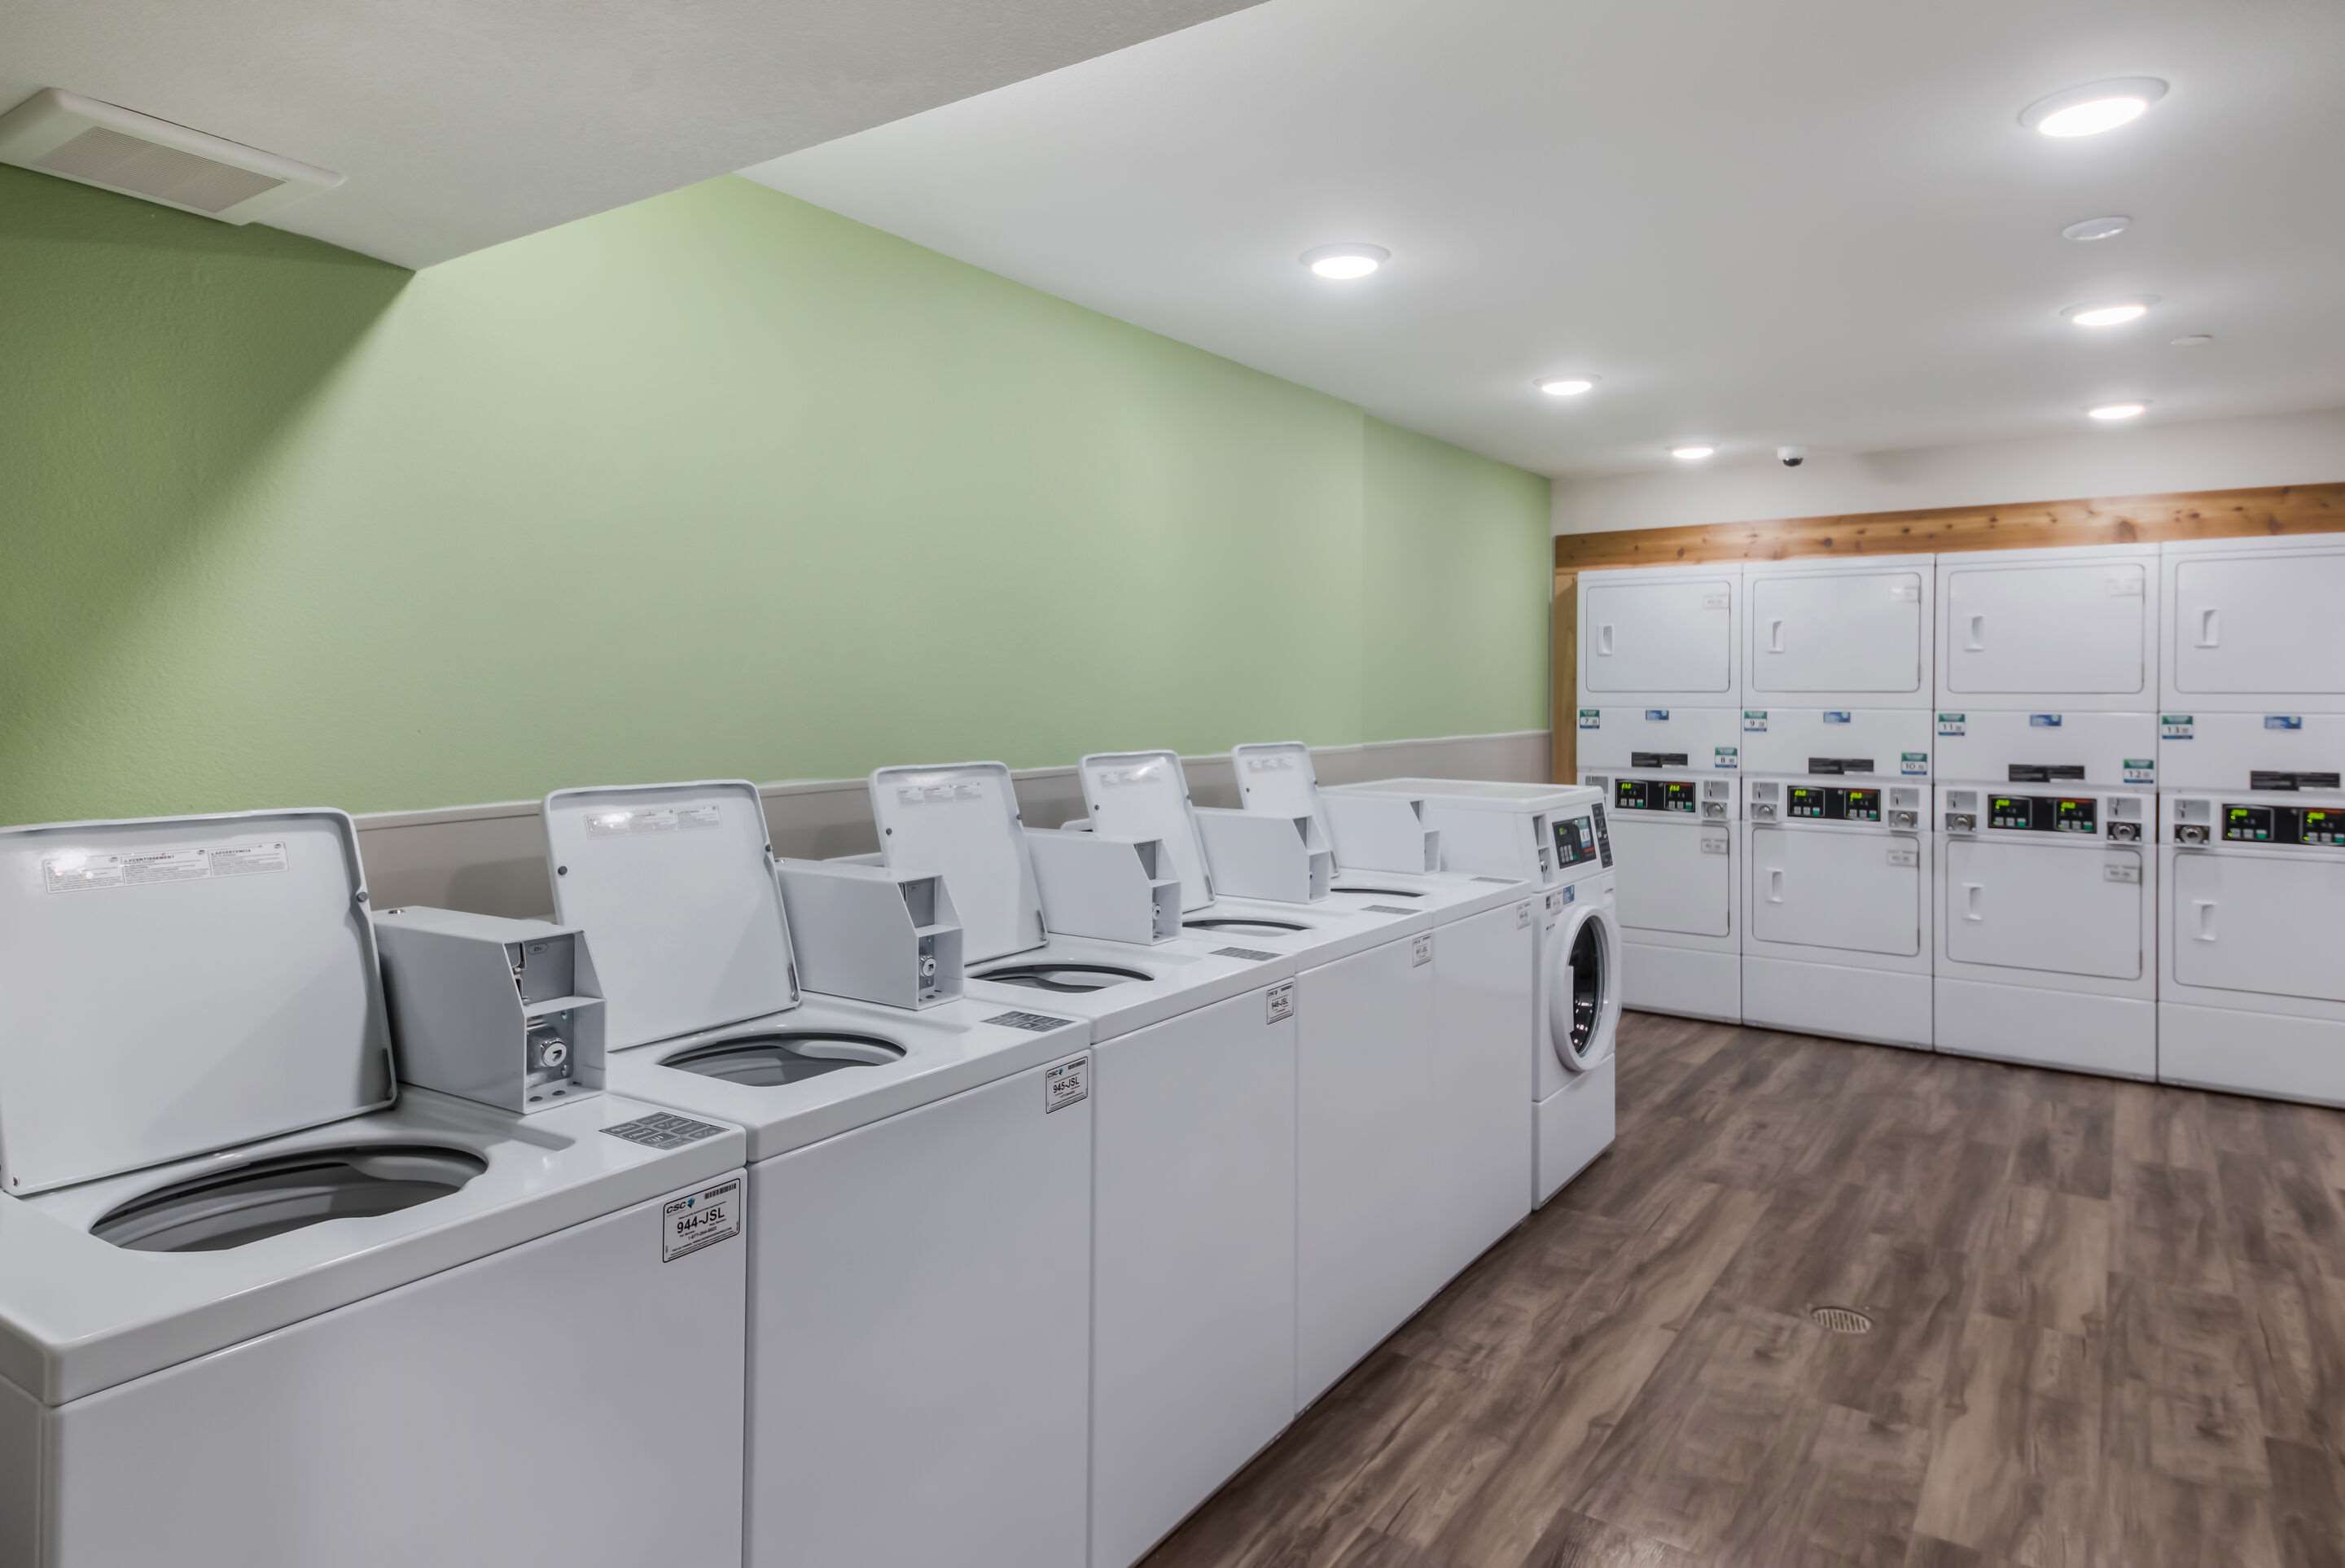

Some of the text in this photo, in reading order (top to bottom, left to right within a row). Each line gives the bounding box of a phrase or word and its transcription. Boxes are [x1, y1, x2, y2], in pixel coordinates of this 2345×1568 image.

[1053, 1075, 1080, 1094] 945-JSL
[666, 1201, 686, 1214] CSC
[677, 1207, 725, 1234] 944-JSL
